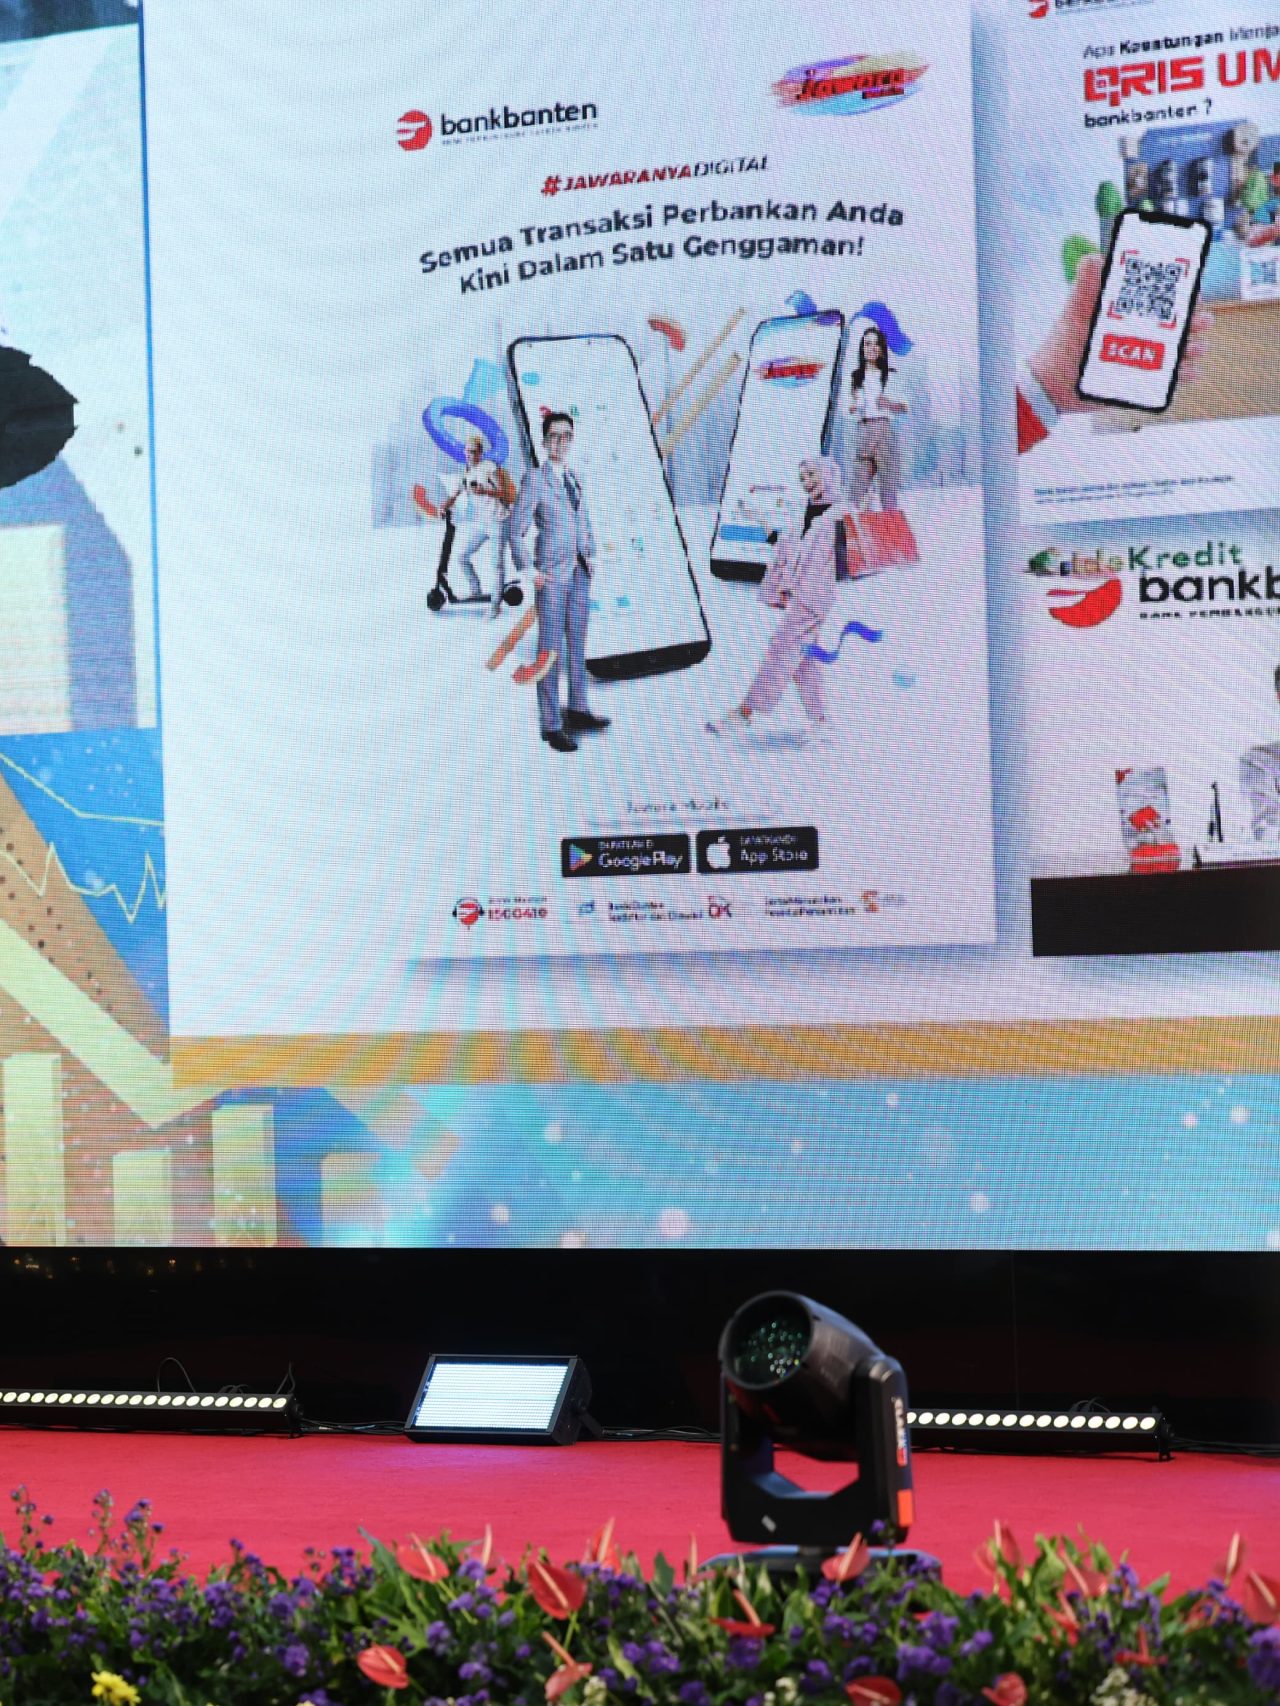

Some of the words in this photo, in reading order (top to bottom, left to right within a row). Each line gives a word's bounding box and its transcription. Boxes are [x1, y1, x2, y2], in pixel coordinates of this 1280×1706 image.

[1084, 56, 1205, 108] QRIS
[441, 102, 597, 136] bankbanten
[419, 235, 513, 274] Semua
[520, 204, 653, 247] Transaksi
[663, 199, 817, 226] Perbankan
[826, 200, 904, 226] Anda
[460, 263, 510, 294] Kini
[518, 252, 604, 281] Dalam
[612, 241, 674, 266] Satu
[683, 235, 864, 260] Genggaman!
[1107, 344, 1157, 363] SCAN
[1128, 541, 1242, 570] Kredit
[598, 853, 651, 871] Google
[740, 848, 769, 867] App
